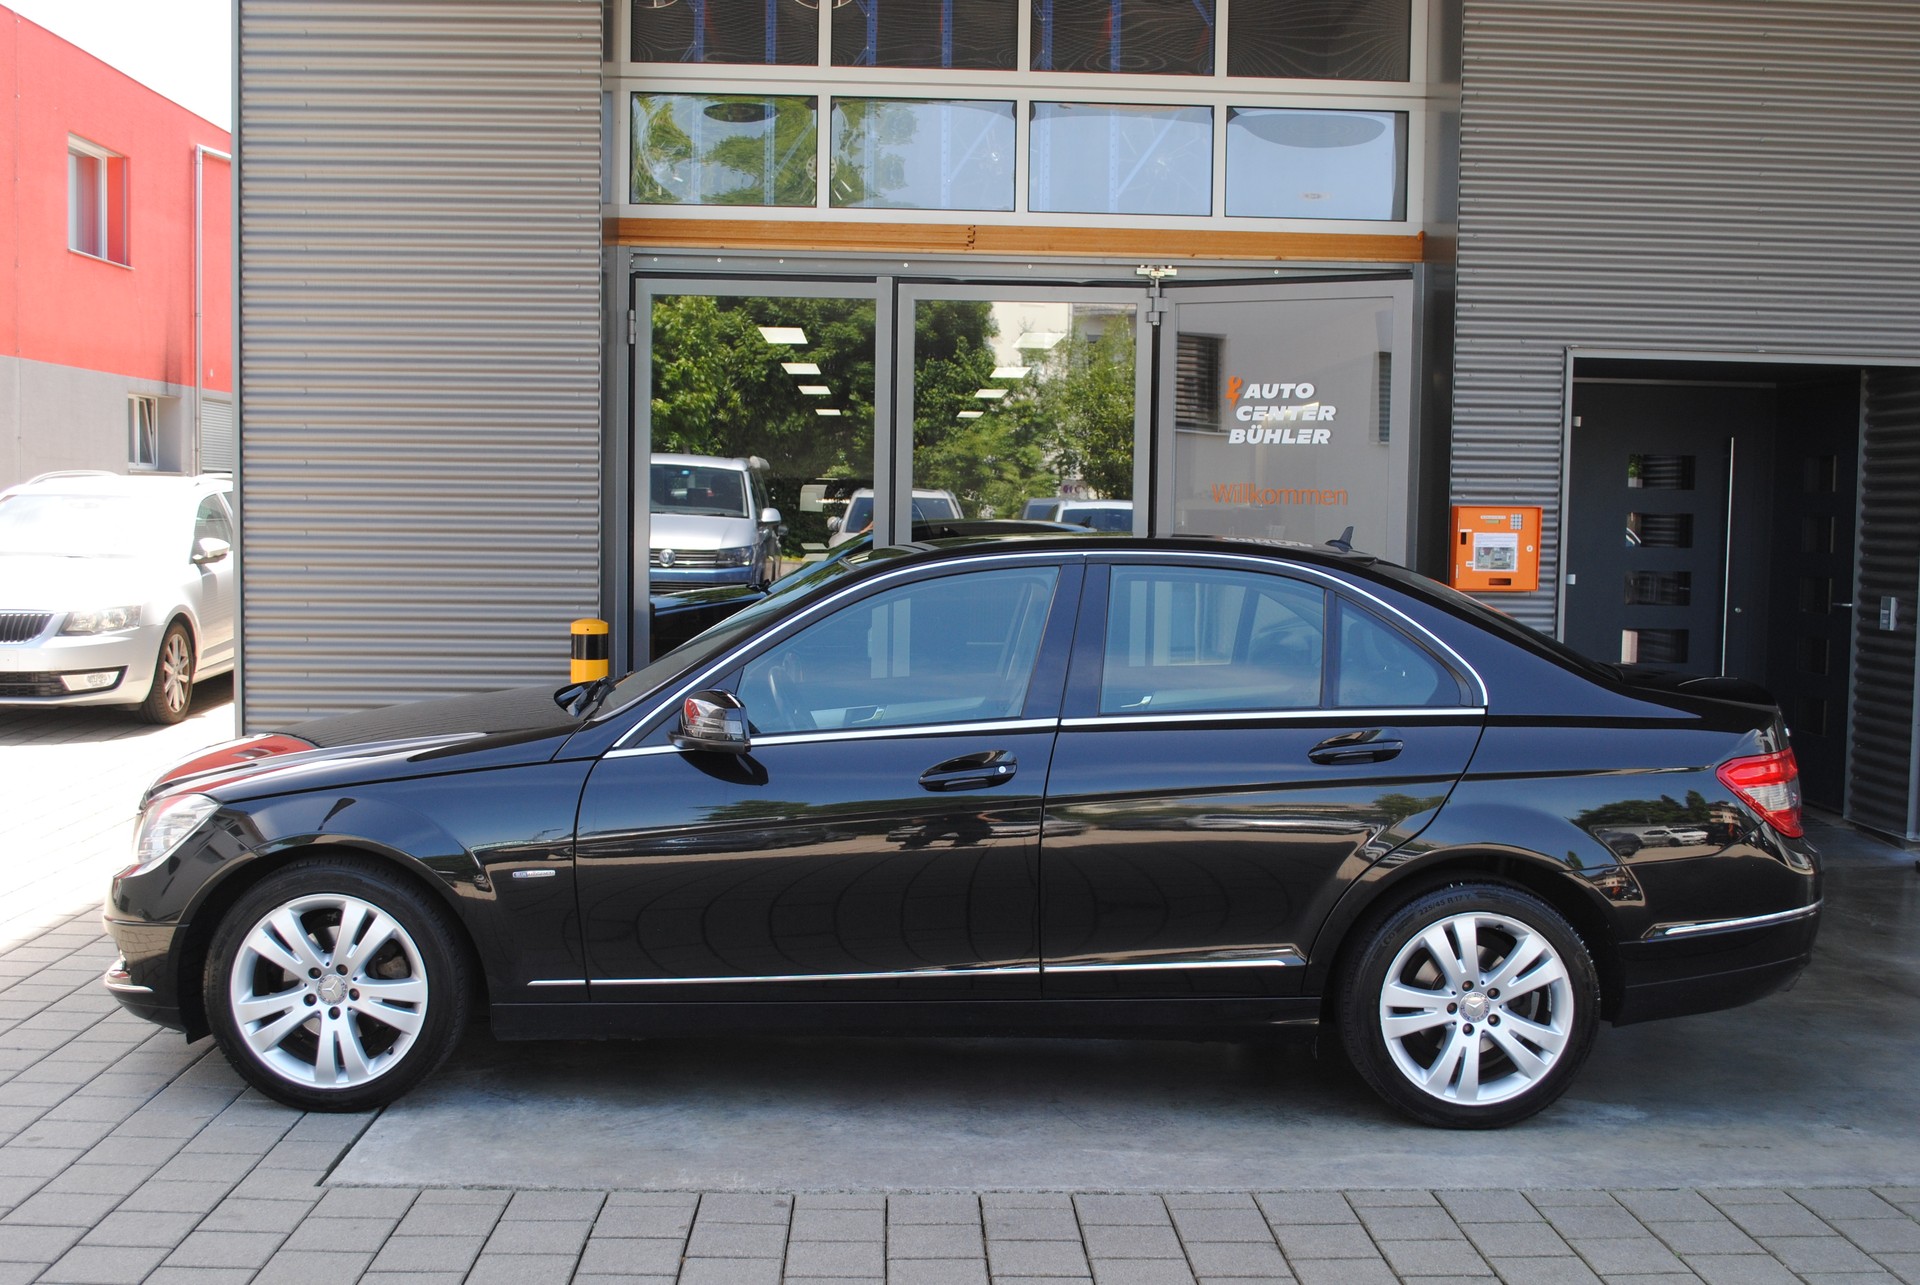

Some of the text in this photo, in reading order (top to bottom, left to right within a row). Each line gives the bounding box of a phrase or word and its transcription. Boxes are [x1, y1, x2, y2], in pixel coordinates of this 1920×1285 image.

[1243, 382, 1315, 399] AUTO
[1236, 405, 1337, 421] CENTER
[1228, 424, 1332, 444] BÜHLER
[1212, 483, 1348, 505] Willkommen
[1418, 899, 1445, 915] 225/45
